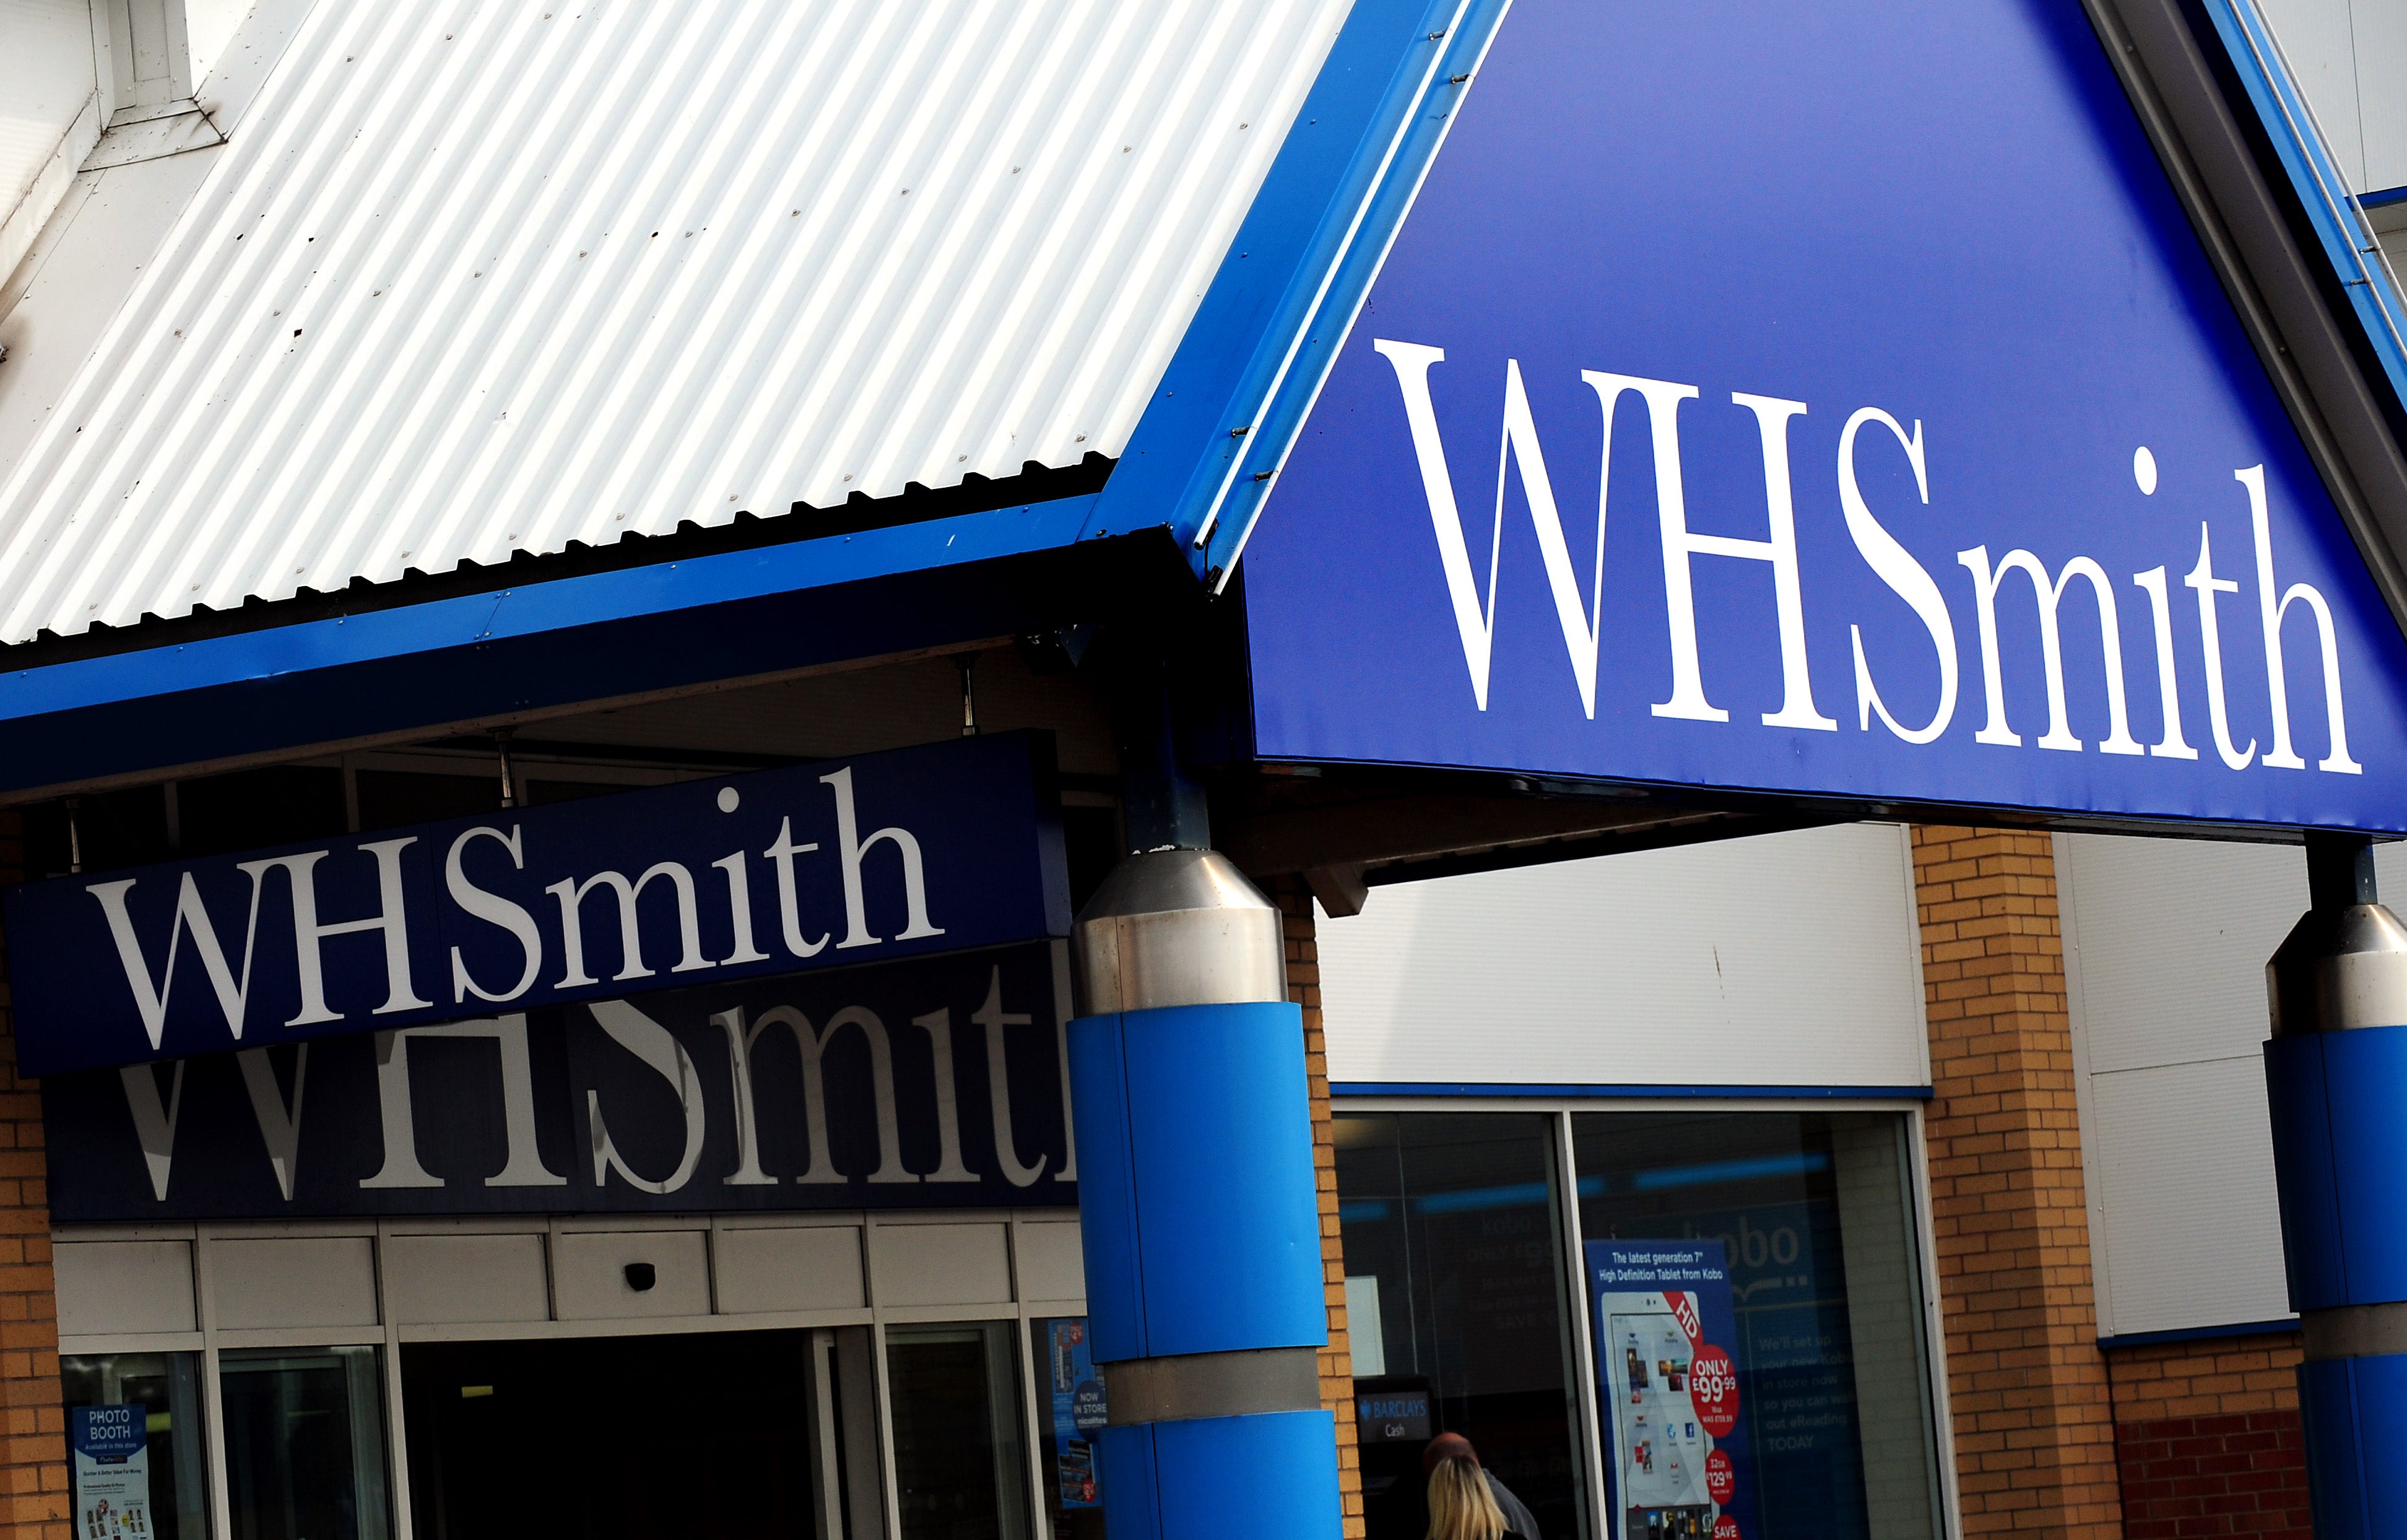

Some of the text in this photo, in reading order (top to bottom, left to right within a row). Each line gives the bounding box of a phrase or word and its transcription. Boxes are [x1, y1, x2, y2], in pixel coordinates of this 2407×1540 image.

[1374, 337, 2362, 776] WHSmith
[85, 765, 945, 1051] WHSmith
[118, 940, 1078, 1202] HSmit
[1684, 1216, 1799, 1268] obo
[1612, 1252, 1627, 1263] The
[1629, 1252, 1651, 1263] latest
[1652, 1252, 1693, 1265] generation
[1599, 1268, 1723, 1283] High Definition Tablet from Kobo
[1676, 1300, 1698, 1338] HD
[1793, 1336, 1812, 1348] set
[1696, 1359, 1728, 1376] ONLY
[1763, 1375, 1838, 1390] in store now
[1080, 1392, 1099, 1402] NOW
[1073, 1404, 1082, 1414] IN
[1083, 1404, 1107, 1414] STORE
[1373, 1399, 1426, 1419] BARCLAYS
[1764, 1399, 1779, 1411] so
[1781, 1398, 1803, 1412] you
[89, 1409, 130, 1424] PHOTO
[1766, 1412, 1847, 1430] out eReading
[90, 1425, 131, 1440] BOOTH
[1385, 1424, 1405, 1437] Cash
[1767, 1435, 1814, 1452] TODAY
[1714, 1525, 1737, 1538] SAVE
